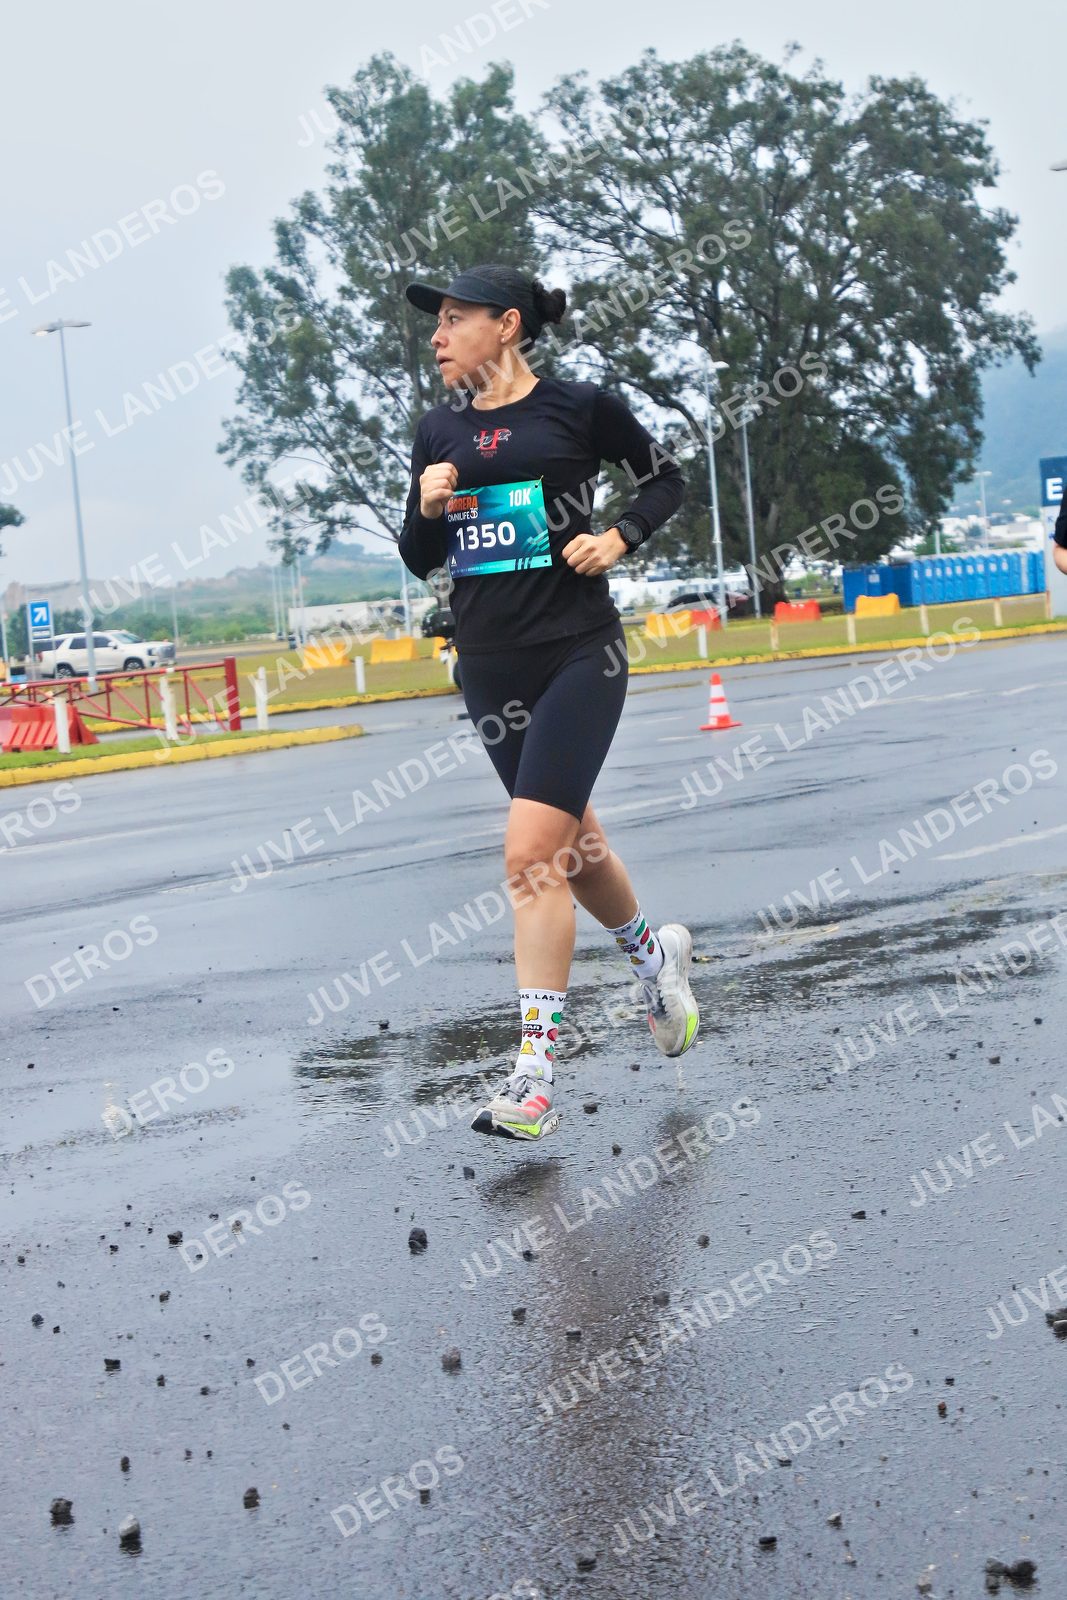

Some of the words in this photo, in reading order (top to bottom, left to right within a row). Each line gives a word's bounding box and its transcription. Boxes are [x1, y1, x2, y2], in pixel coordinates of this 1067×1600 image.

[509, 488, 531, 507] 10K
[448, 511, 470, 522] OMNILIFE
[456, 521, 516, 551] 1350
